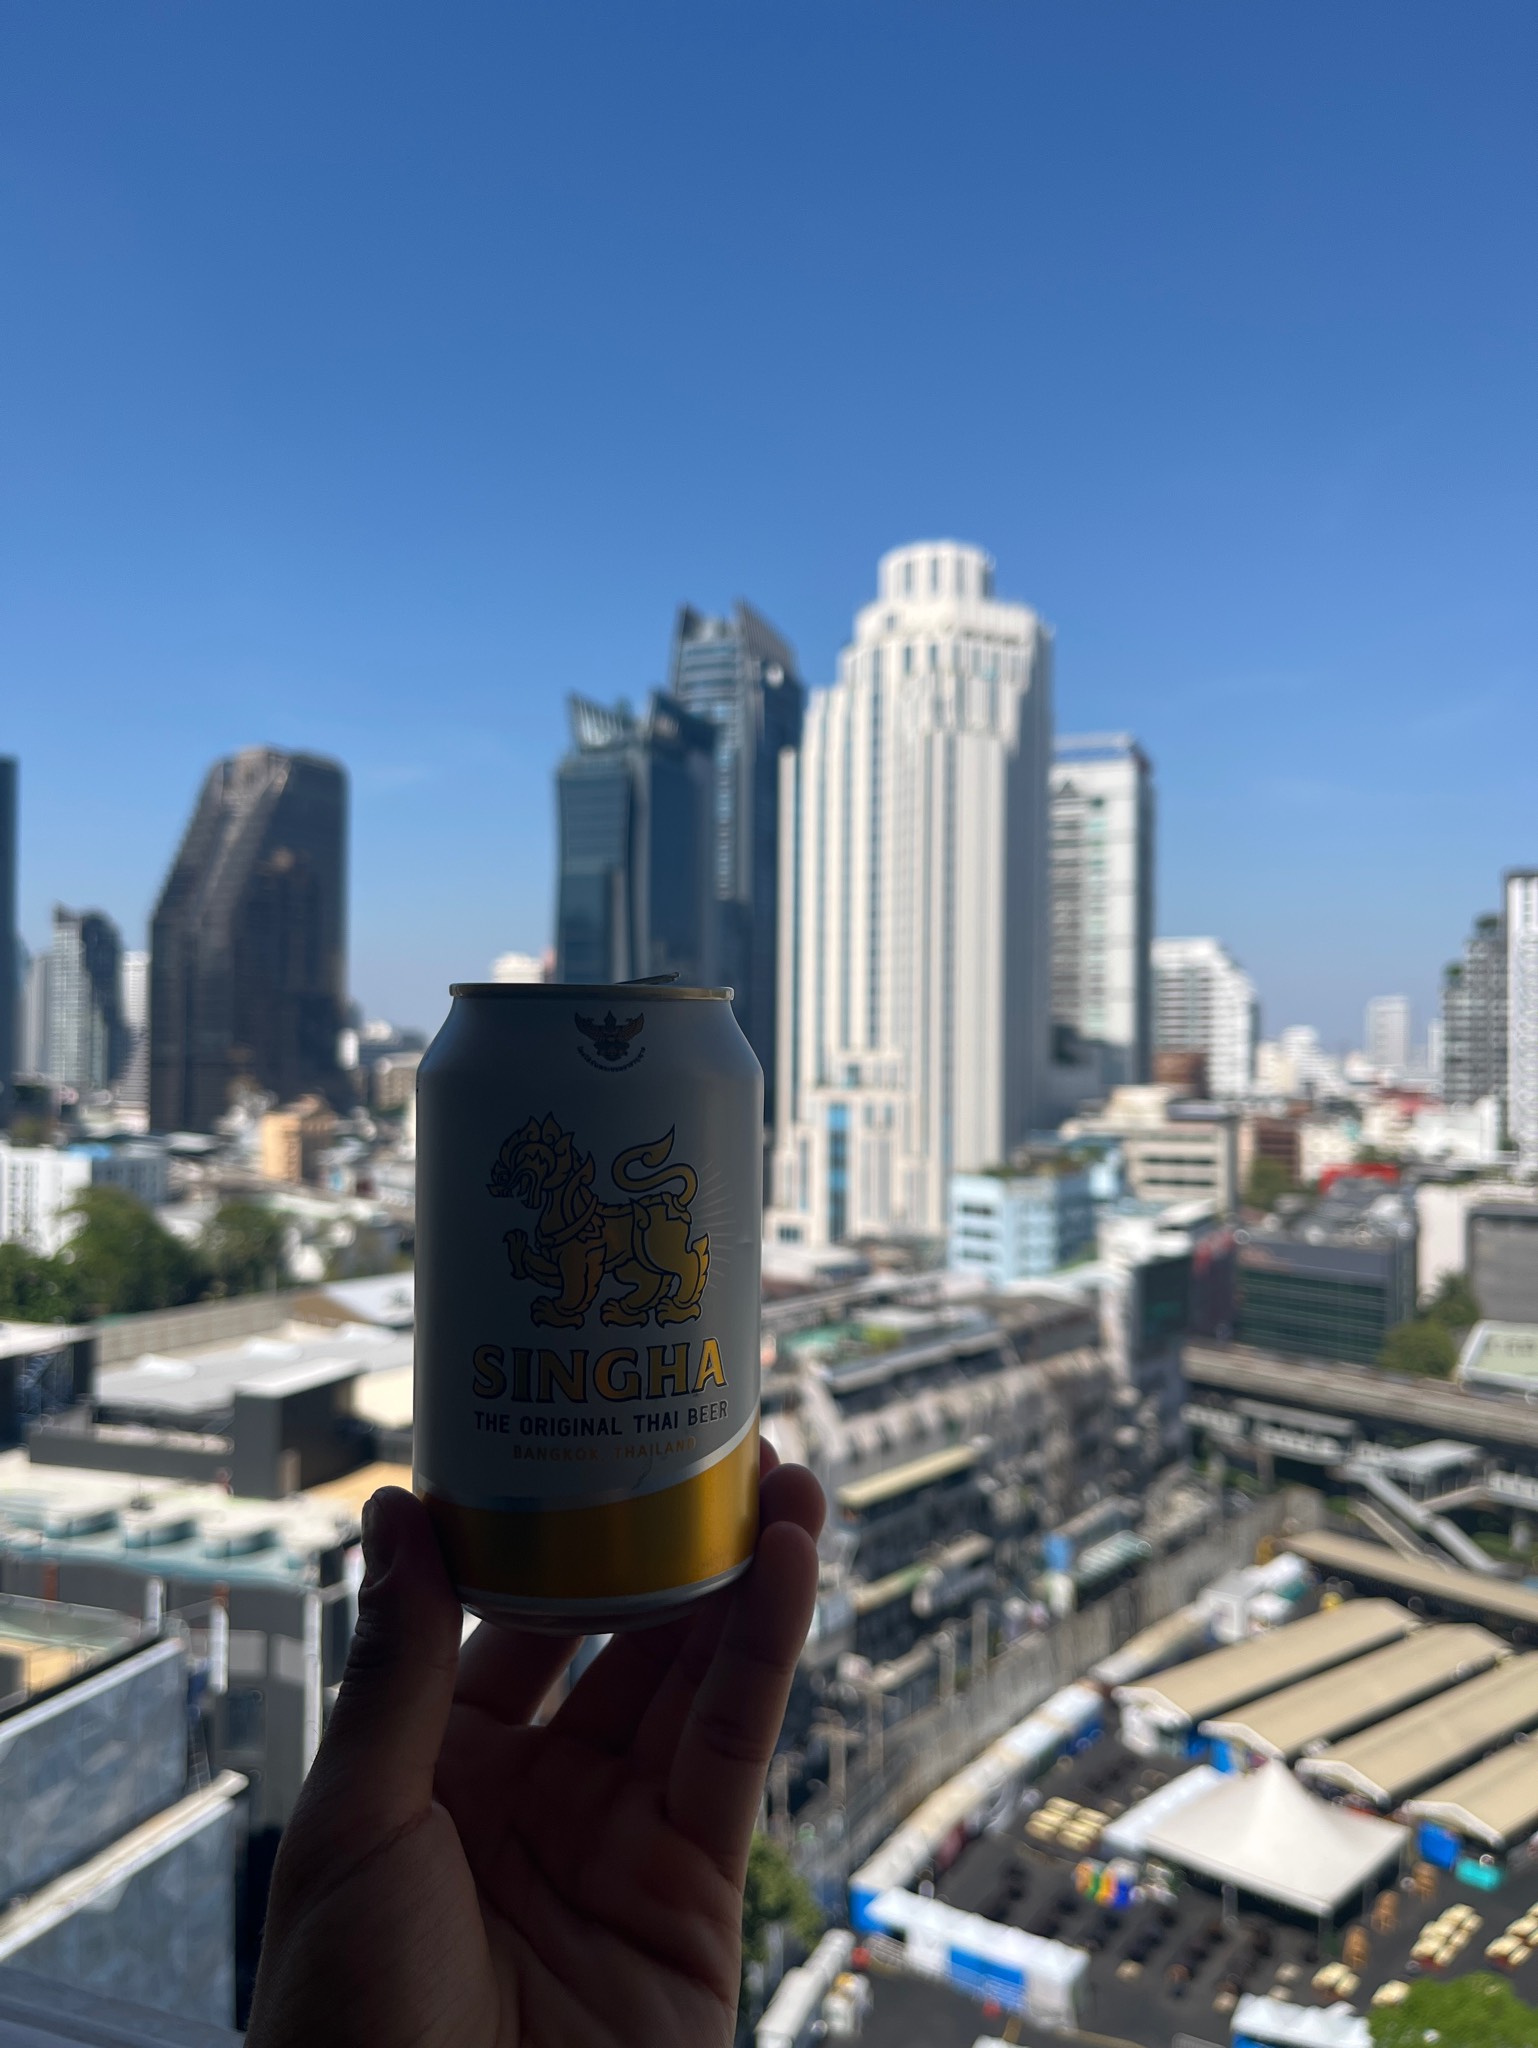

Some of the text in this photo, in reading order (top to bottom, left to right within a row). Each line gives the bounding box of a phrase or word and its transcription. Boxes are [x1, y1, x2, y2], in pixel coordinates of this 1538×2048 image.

[472, 1337, 728, 1403] SINGHA
[474, 1400, 729, 1437] THE ORIGINAL THAI BEER
[614, 1436, 697, 1460] THAILAND
